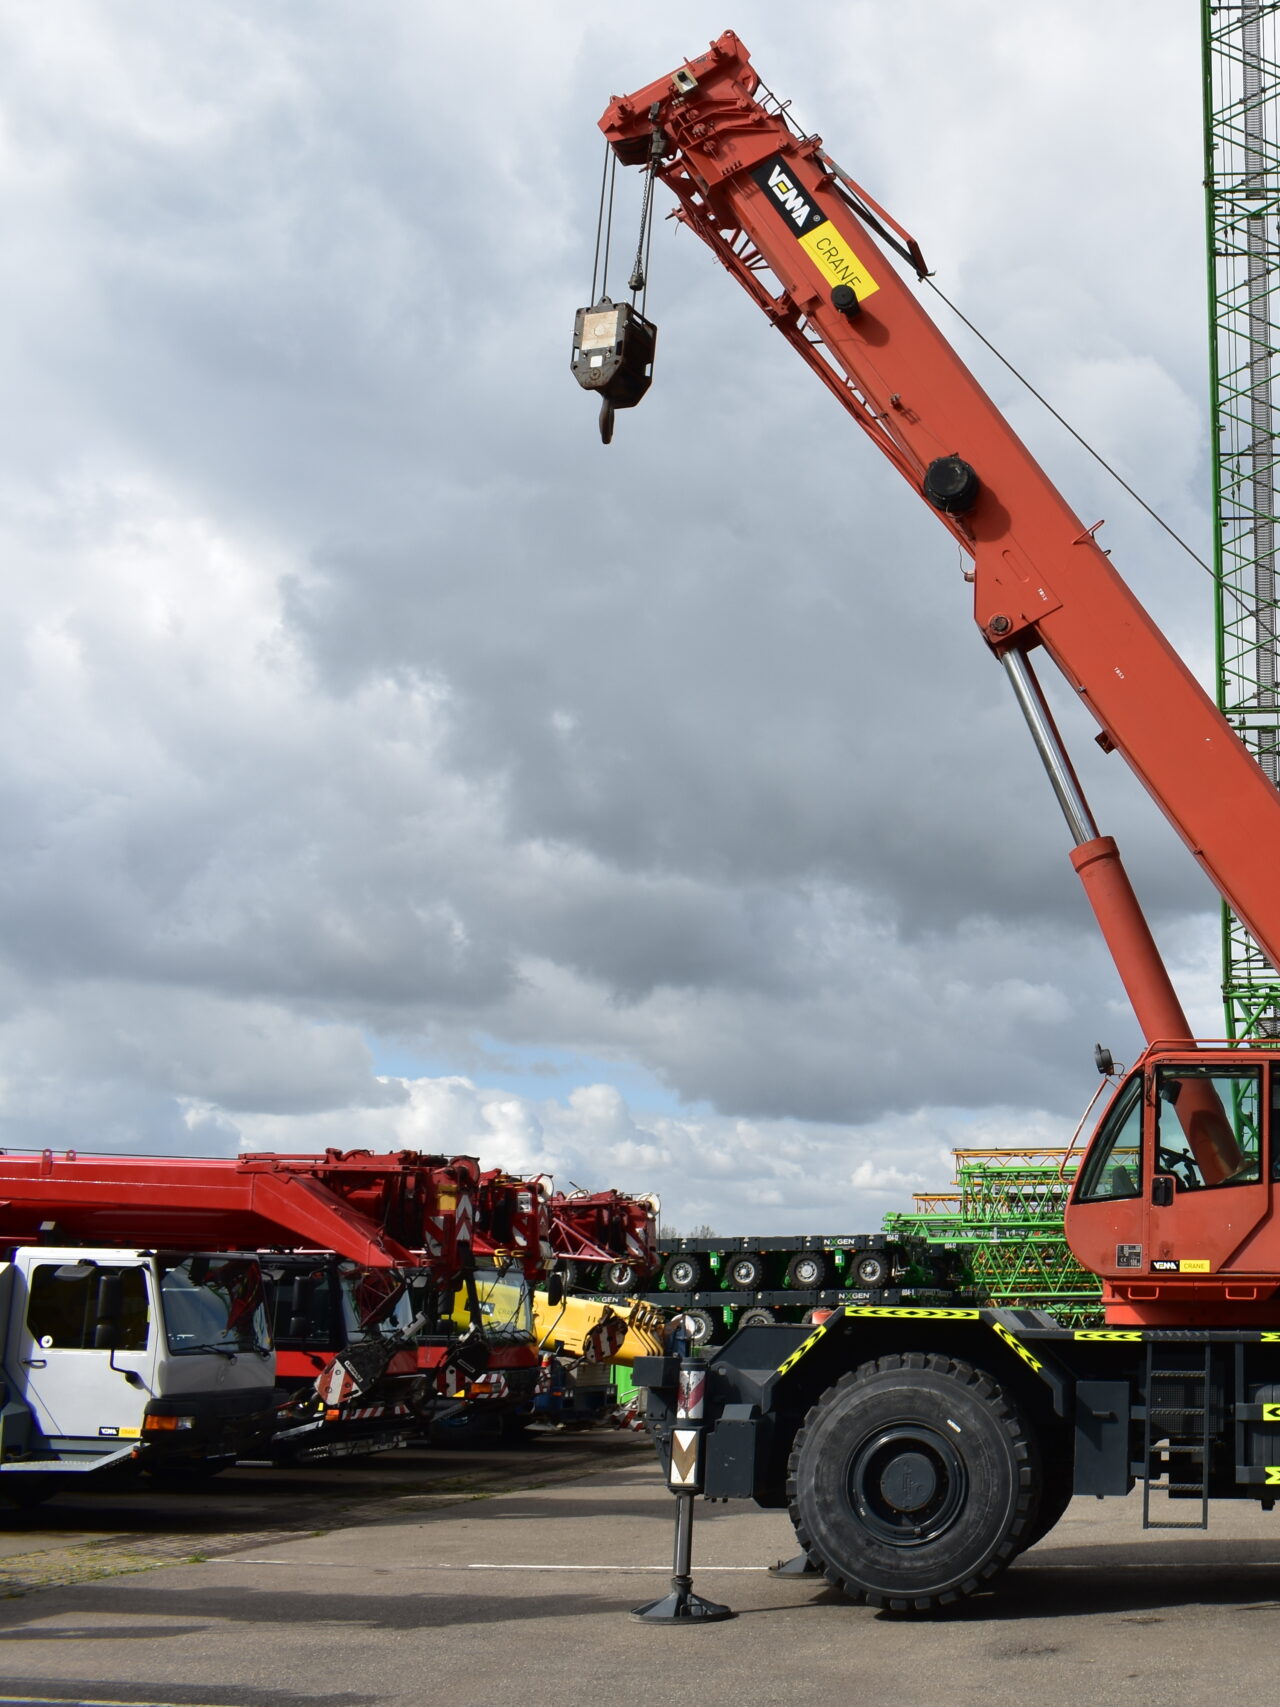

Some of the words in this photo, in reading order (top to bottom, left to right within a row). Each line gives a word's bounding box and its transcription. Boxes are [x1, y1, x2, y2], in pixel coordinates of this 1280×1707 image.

[767, 164, 811, 228] VEMA
[823, 1238, 854, 1246] NXGEN
[1153, 1262, 1177, 1270] VEMA
[838, 1292, 870, 1300] NXGEN
